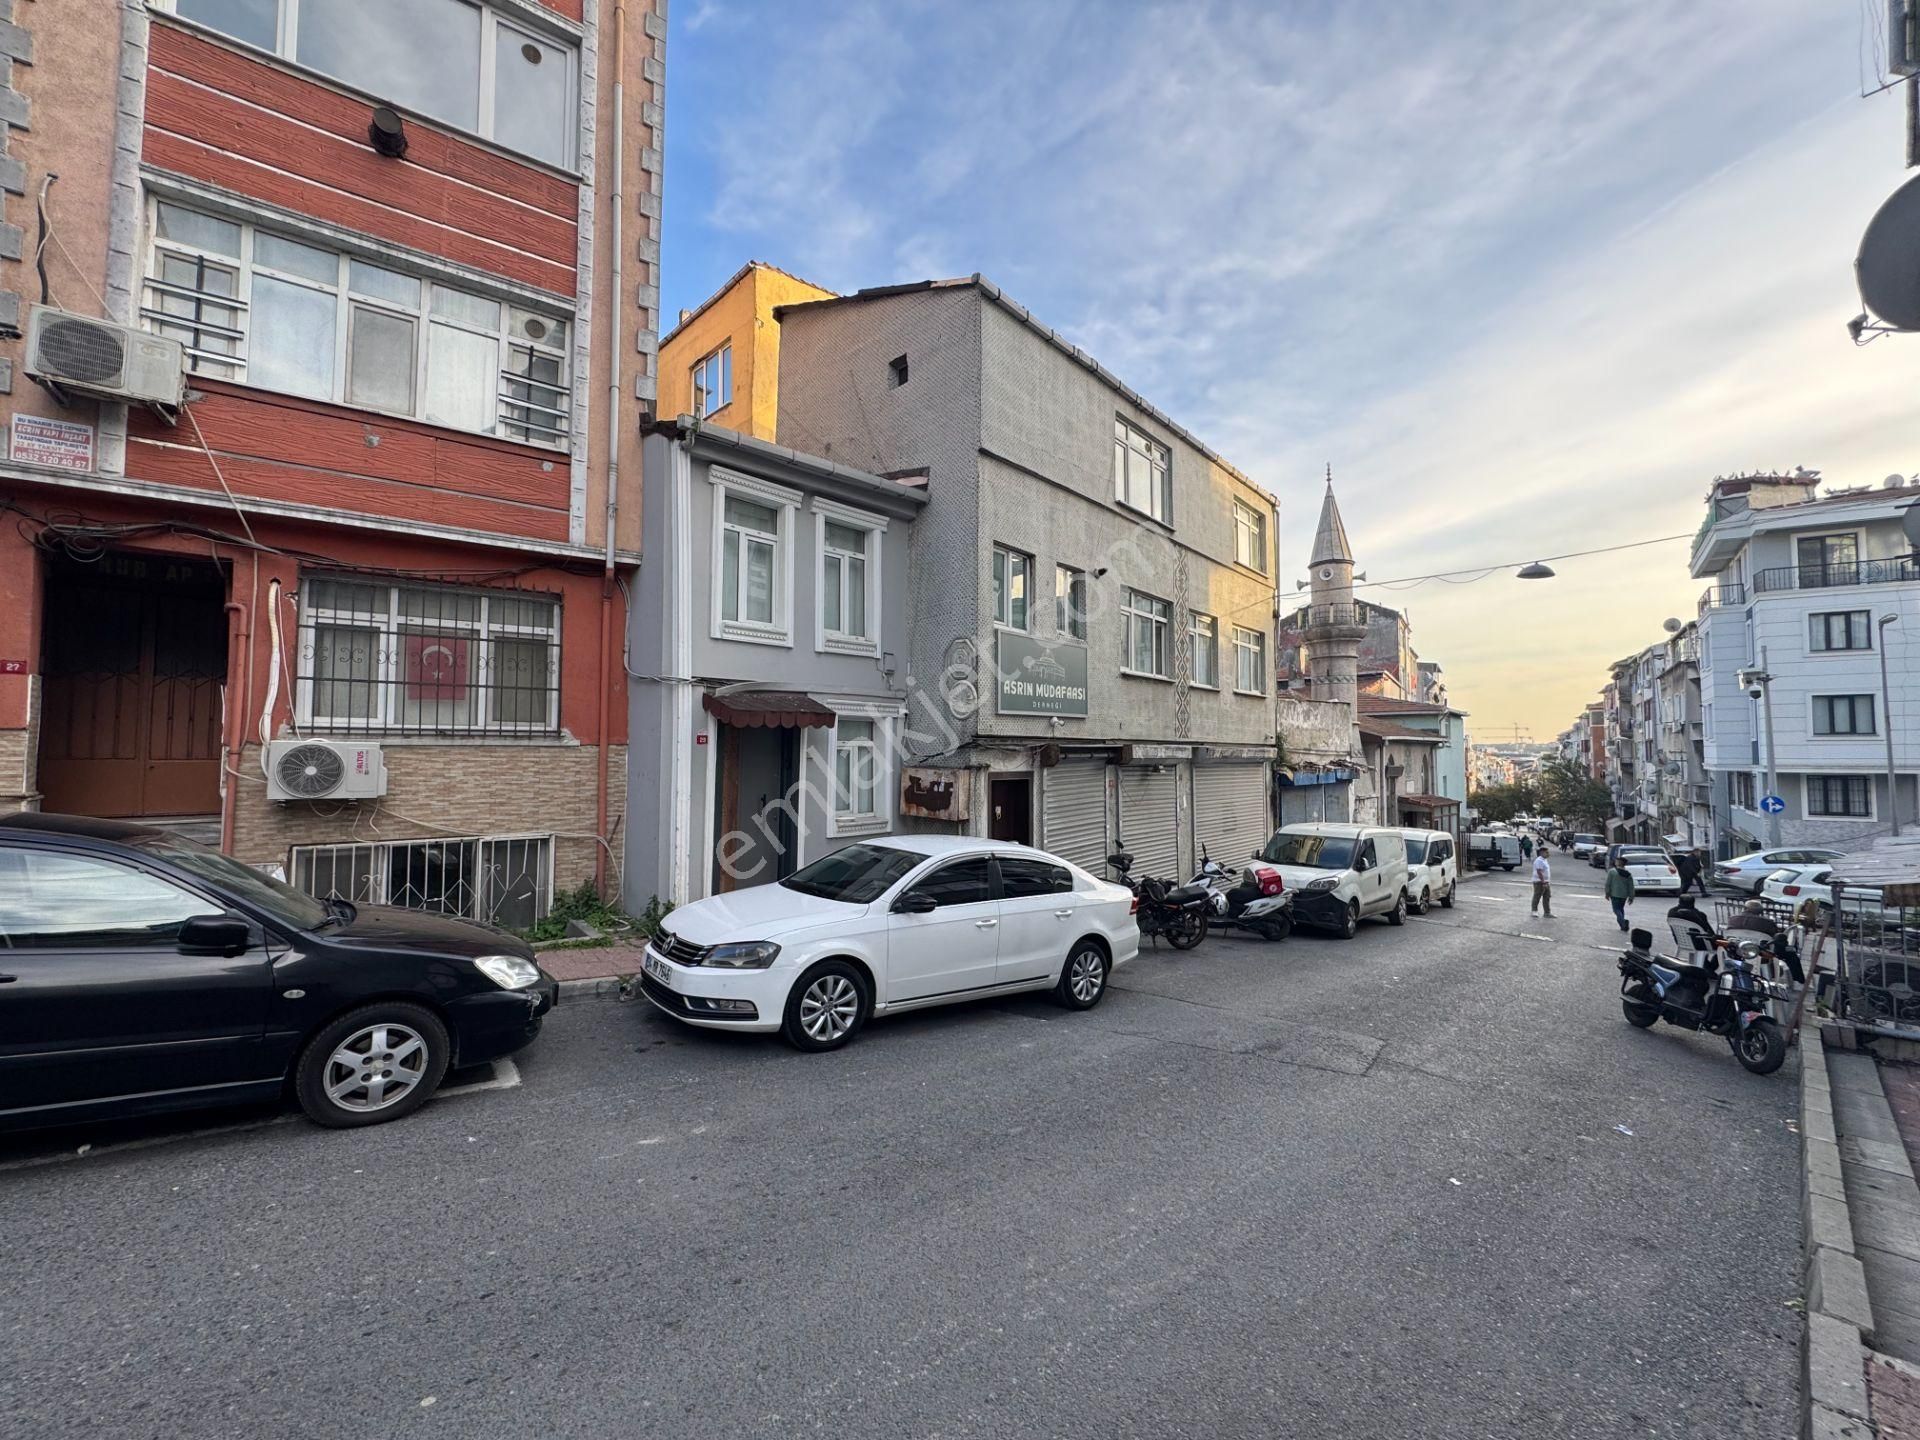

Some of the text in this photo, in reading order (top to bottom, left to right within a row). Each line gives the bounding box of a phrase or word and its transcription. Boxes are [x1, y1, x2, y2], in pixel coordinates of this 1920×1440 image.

[41, 455, 59, 465] 120
[61, 459, 73, 467] 40
[6, 663, 20, 671] 27
[1003, 680, 1033, 697] ASRIN
